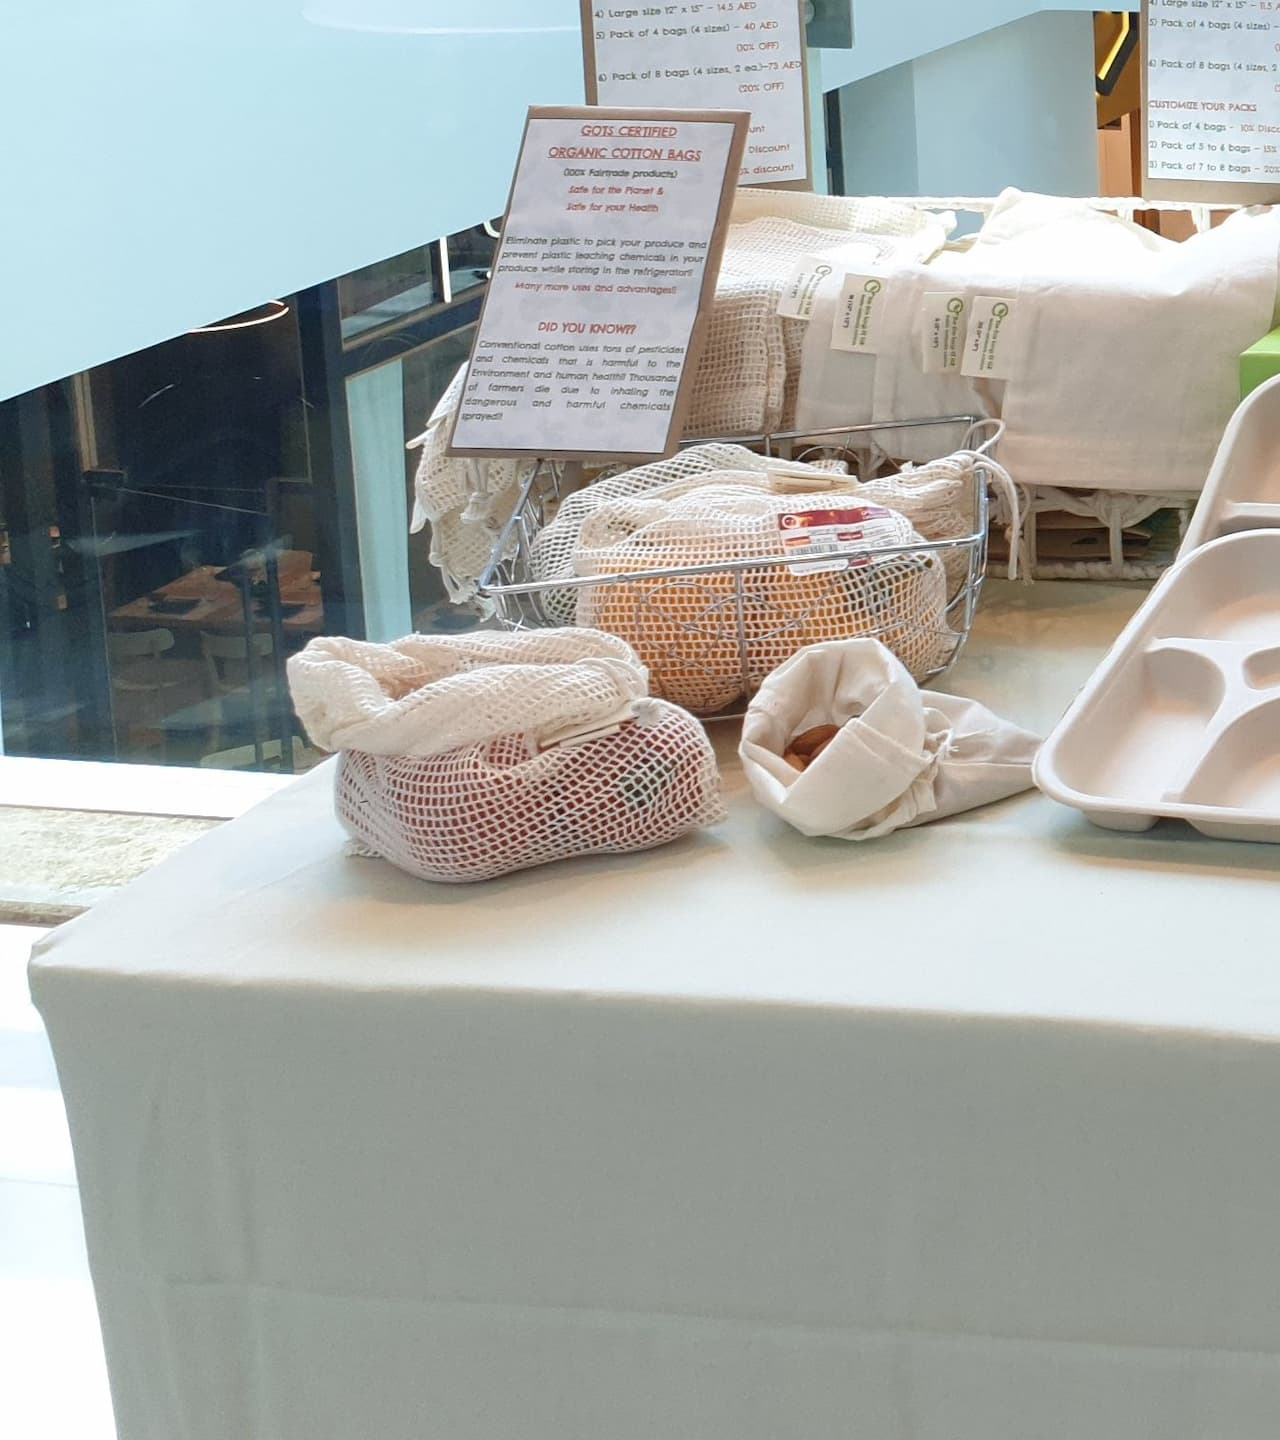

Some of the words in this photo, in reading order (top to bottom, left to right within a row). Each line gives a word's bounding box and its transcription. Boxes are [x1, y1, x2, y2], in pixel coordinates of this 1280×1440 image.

[1201, 103, 1225, 111] YOUR
[1228, 103, 1257, 112] PACKS
[581, 126, 614, 137] GOTS
[618, 126, 678, 138] CERTIFIED
[548, 147, 608, 159] ORGANIC
[611, 148, 663, 160] COTTON
[668, 149, 702, 161] BAGS
[538, 322, 558, 333] DID
[562, 322, 586, 333] YOU
[590, 323, 637, 335] KNOW??
